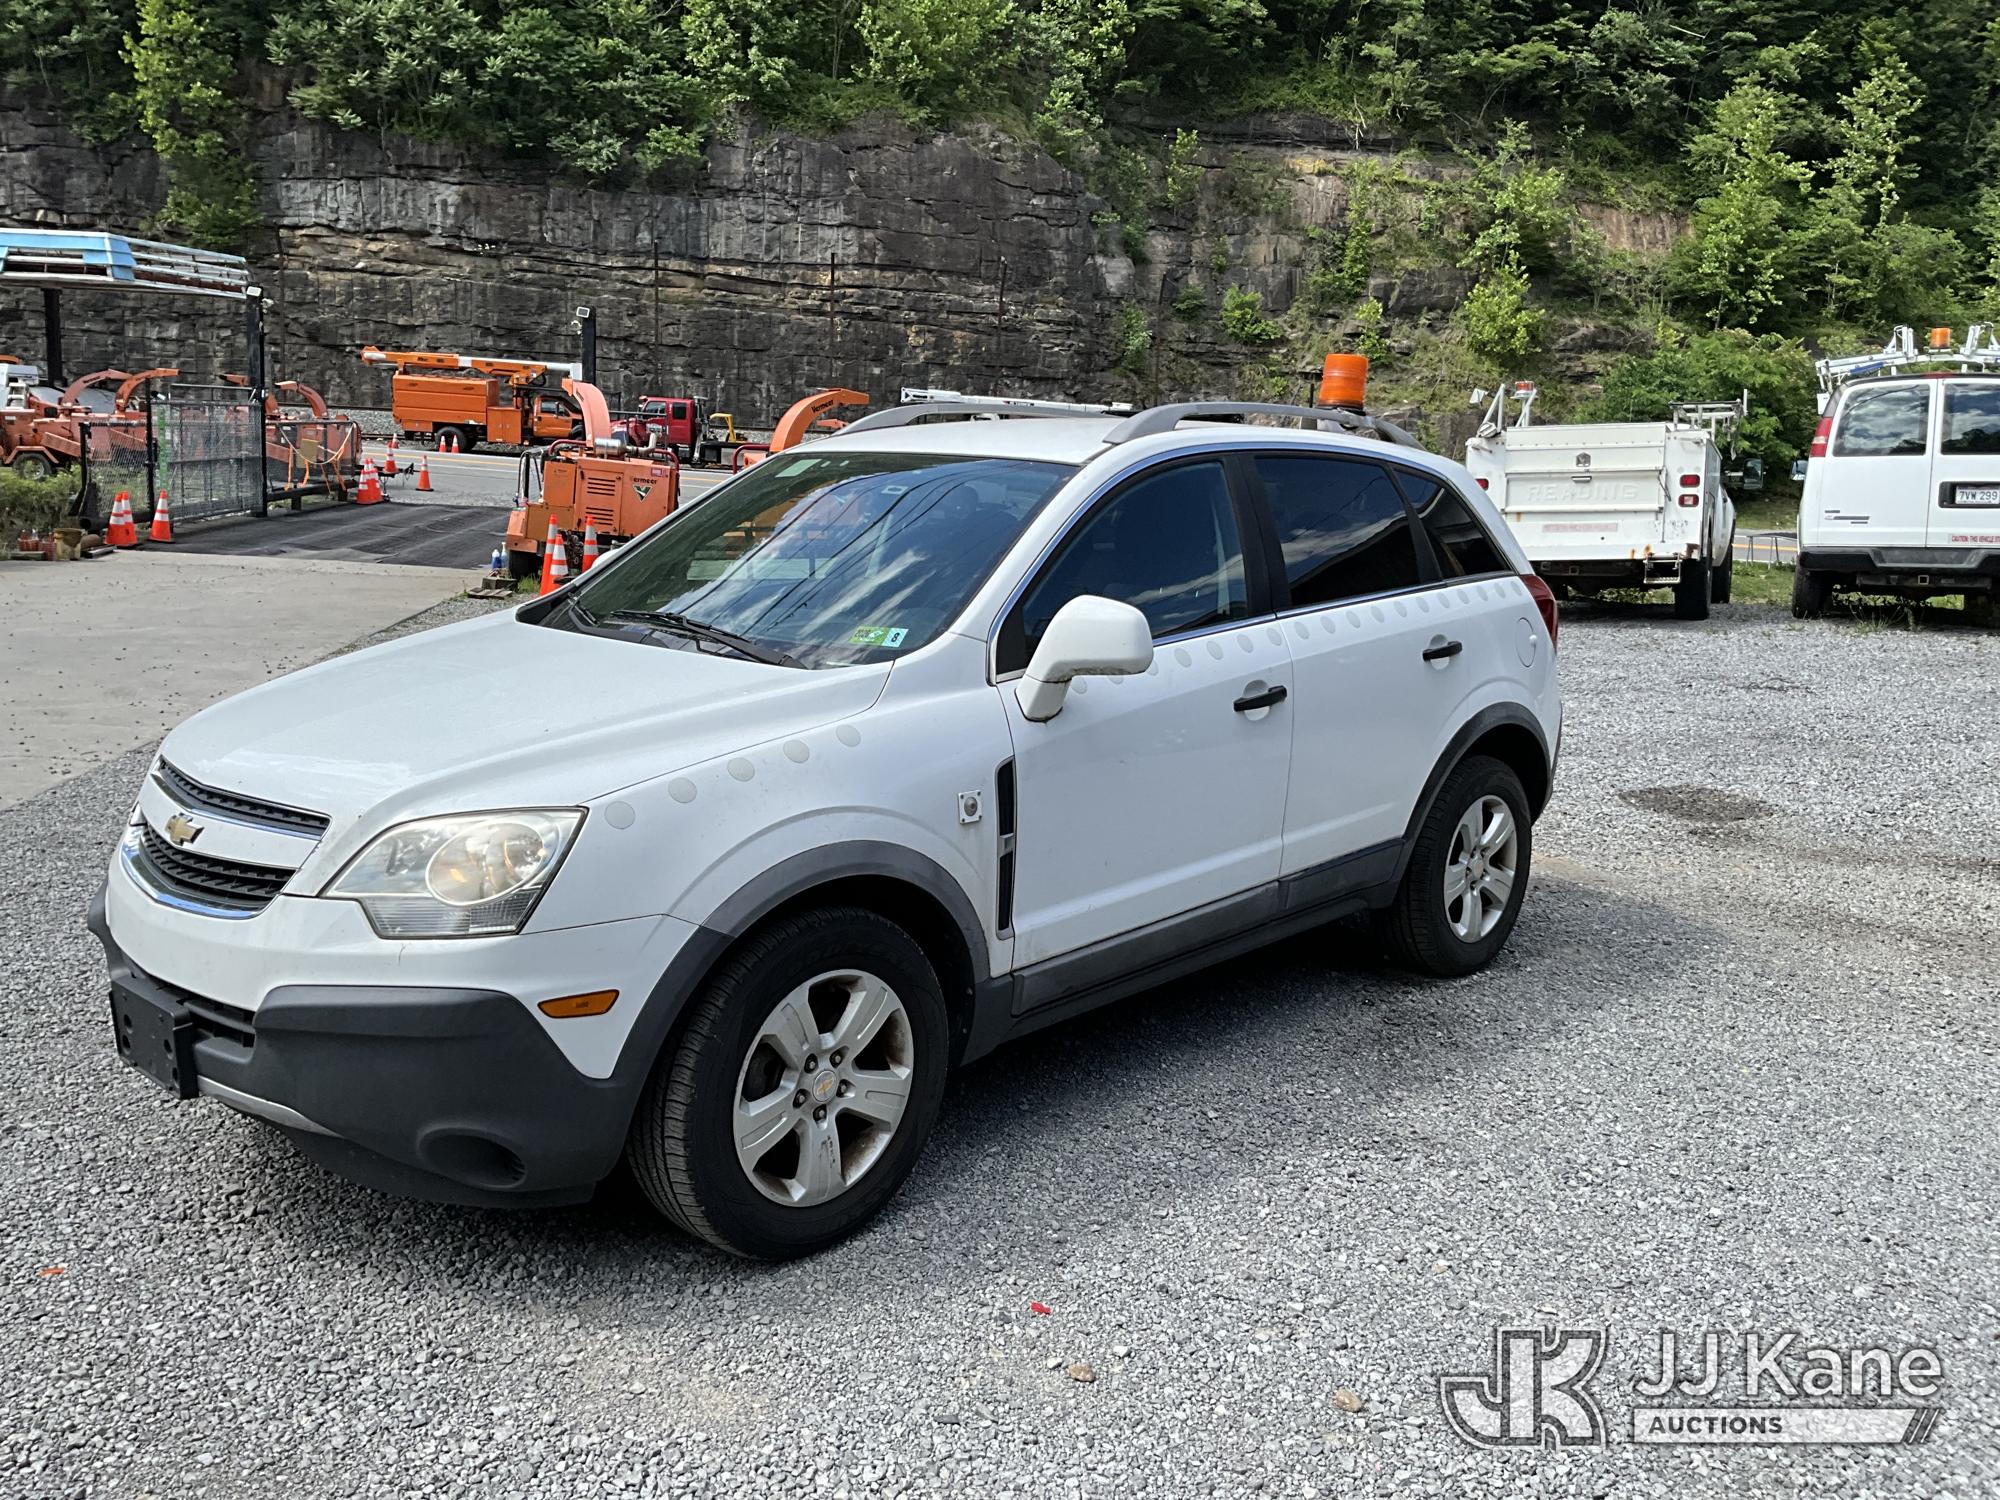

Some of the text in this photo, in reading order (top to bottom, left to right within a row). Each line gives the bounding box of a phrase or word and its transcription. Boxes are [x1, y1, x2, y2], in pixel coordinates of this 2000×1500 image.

[811, 400, 833, 413] Vermeer
[631, 476, 657, 484] ermeer
[1528, 484, 1639, 501] READING
[1960, 491, 1998, 500] 7VW 299
[891, 632, 901, 642] 8
